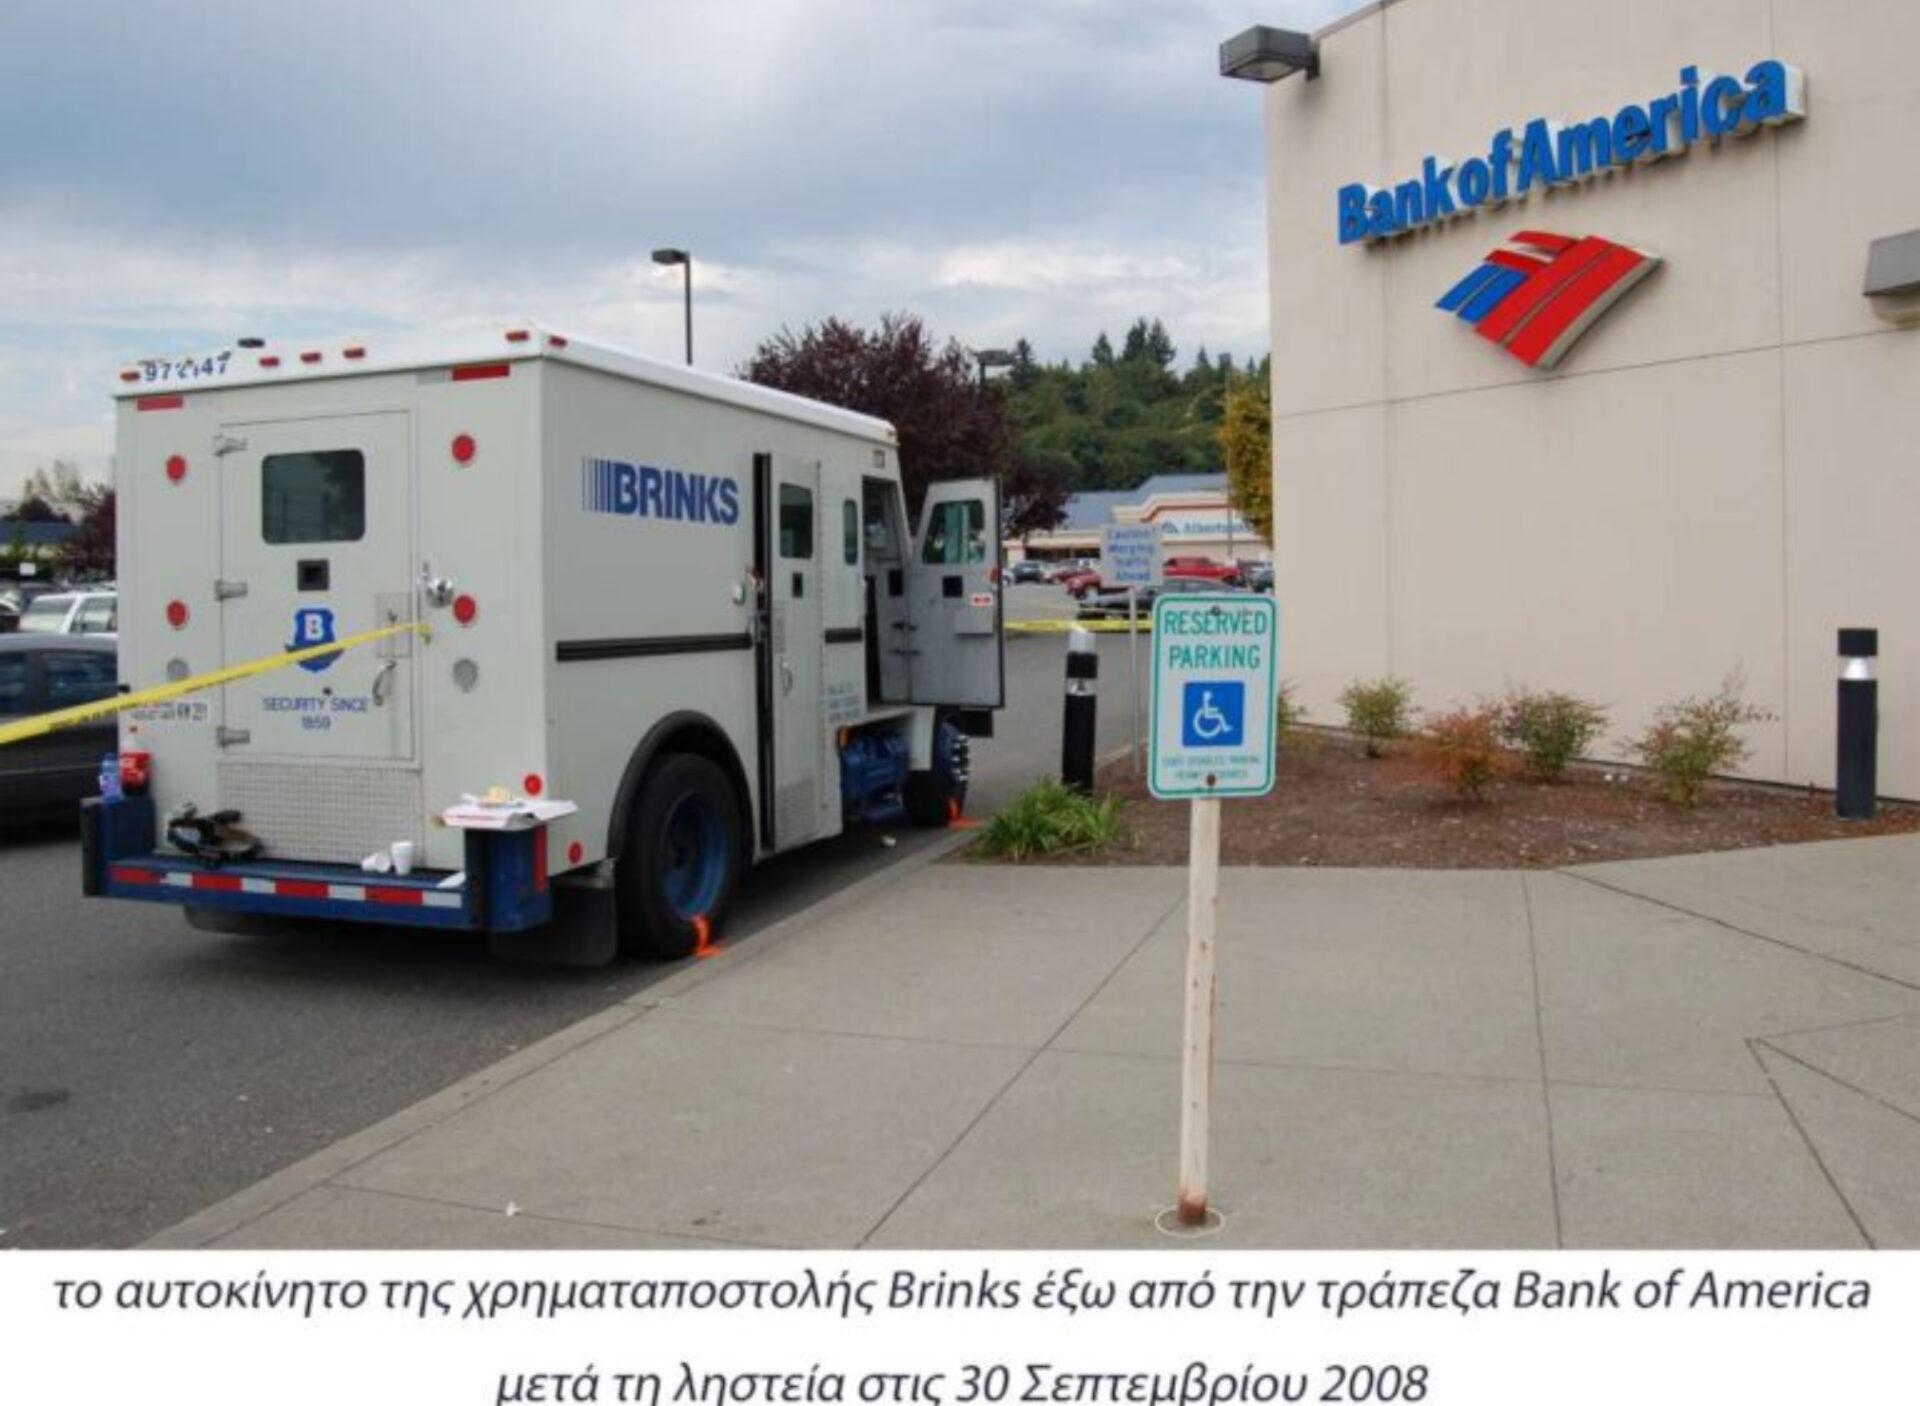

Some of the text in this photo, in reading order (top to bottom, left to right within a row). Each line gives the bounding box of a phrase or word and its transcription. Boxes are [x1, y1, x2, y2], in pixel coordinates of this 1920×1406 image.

[1338, 59, 1790, 245] Bank of America
[608, 461, 740, 526] BRINKS
[304, 612, 324, 640] B
[1164, 609, 1267, 635] RESERVED
[1169, 644, 1261, 670] PARKING
[262, 697, 368, 712] SECURITY SINCE
